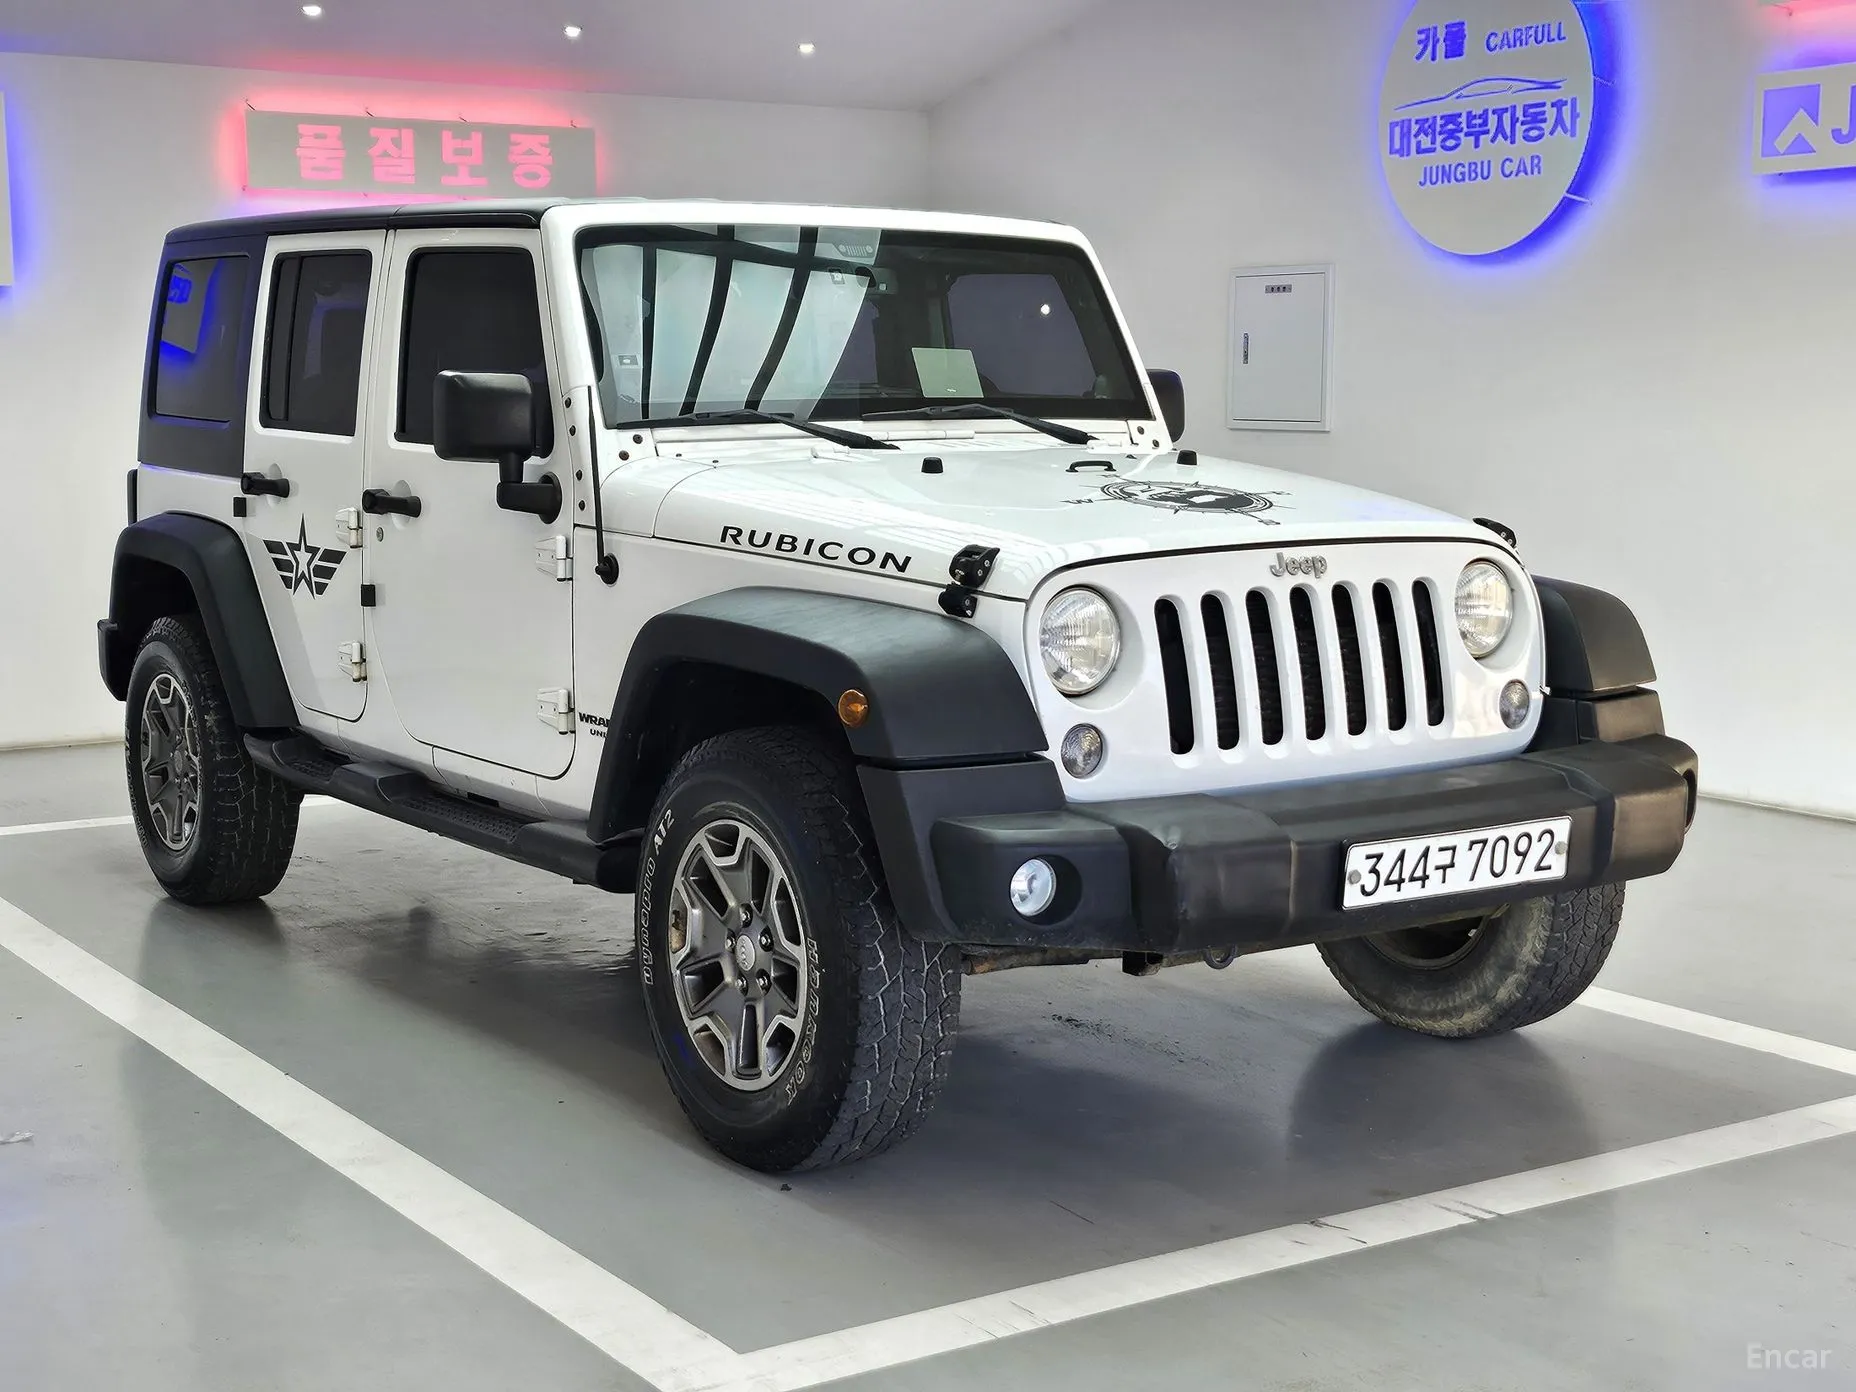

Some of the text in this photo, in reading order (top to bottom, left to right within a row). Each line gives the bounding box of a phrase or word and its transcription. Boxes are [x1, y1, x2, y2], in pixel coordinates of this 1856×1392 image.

[1485, 22, 1567, 53] CARFULL
[1389, 97, 1580, 158] 대전중부자동차
[296, 124, 552, 189] 품질보증
[1418, 154, 1542, 187] JUNGBU CAR
[719, 525, 912, 573] RUBICON
[1269, 552, 1328, 578] Jeep
[654, 809, 675, 856] AT2
[1360, 828, 1555, 896] 344구 7092
